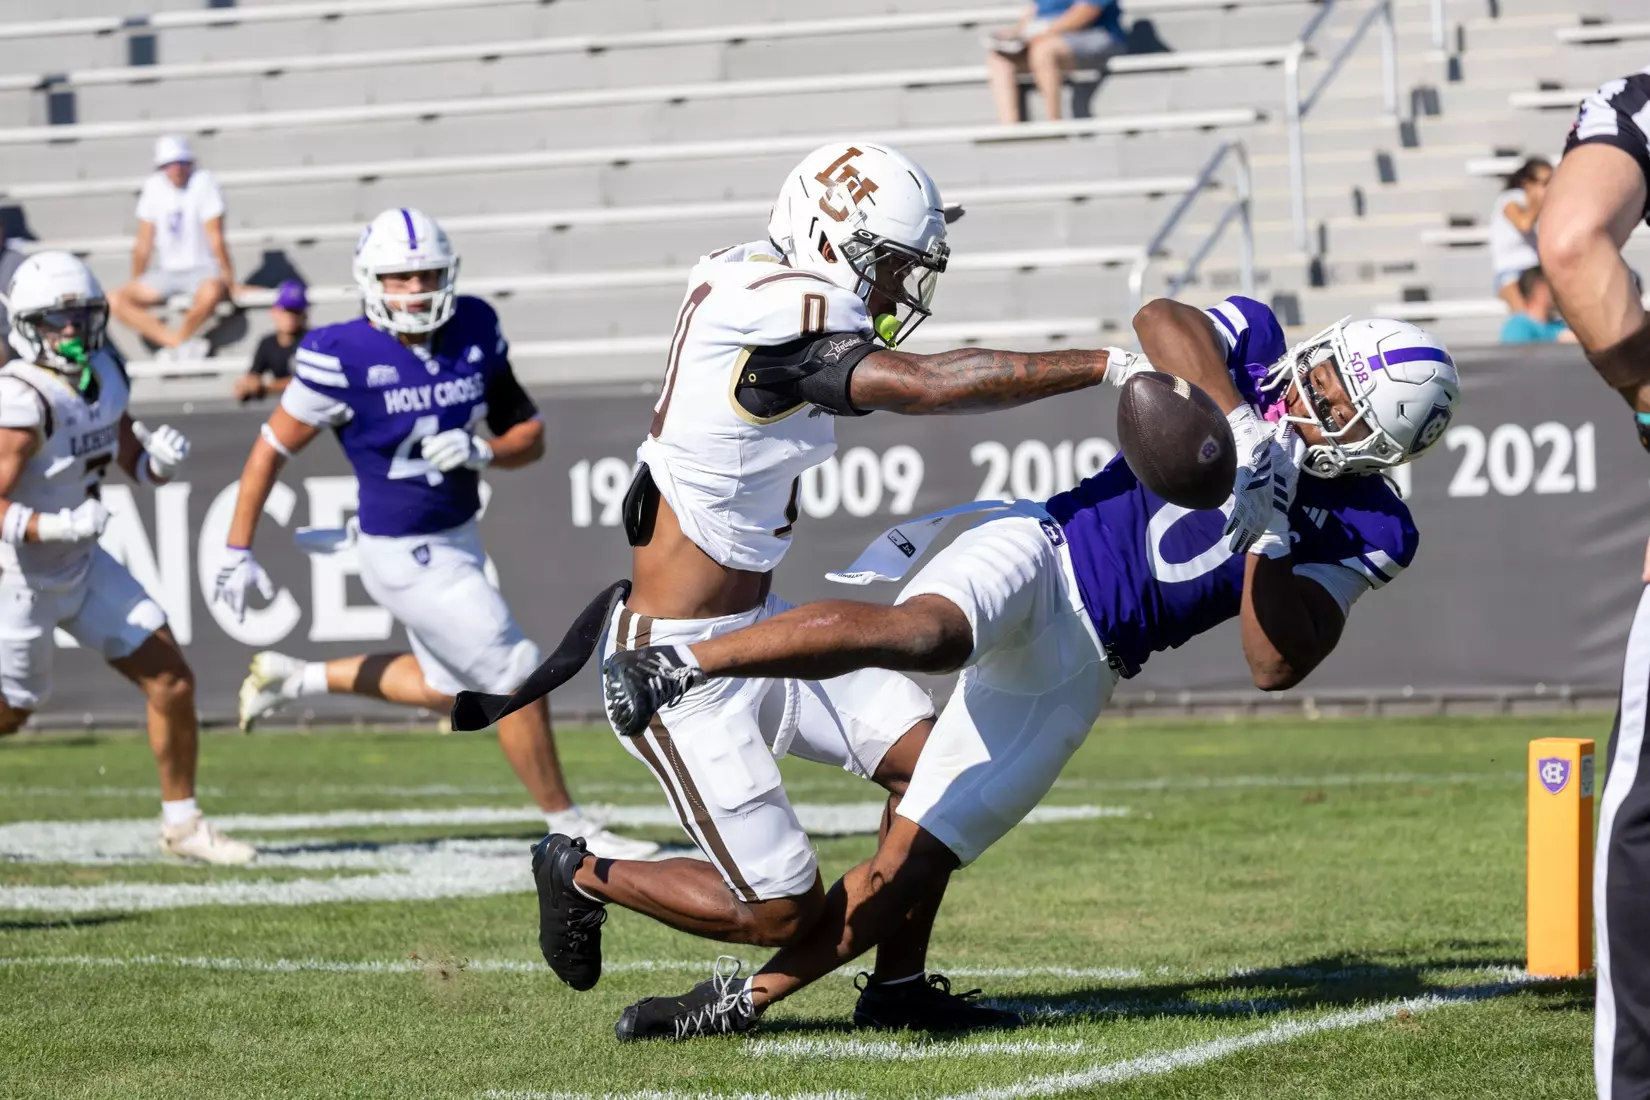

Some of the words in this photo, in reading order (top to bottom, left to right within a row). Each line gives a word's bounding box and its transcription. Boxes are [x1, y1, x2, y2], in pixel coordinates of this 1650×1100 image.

[1352, 351, 1370, 384] 508
[383, 384, 432, 415] HOLY
[433, 372, 484, 408] CROSS
[801, 445, 924, 519] 009
[1445, 421, 1597, 498] 2021
